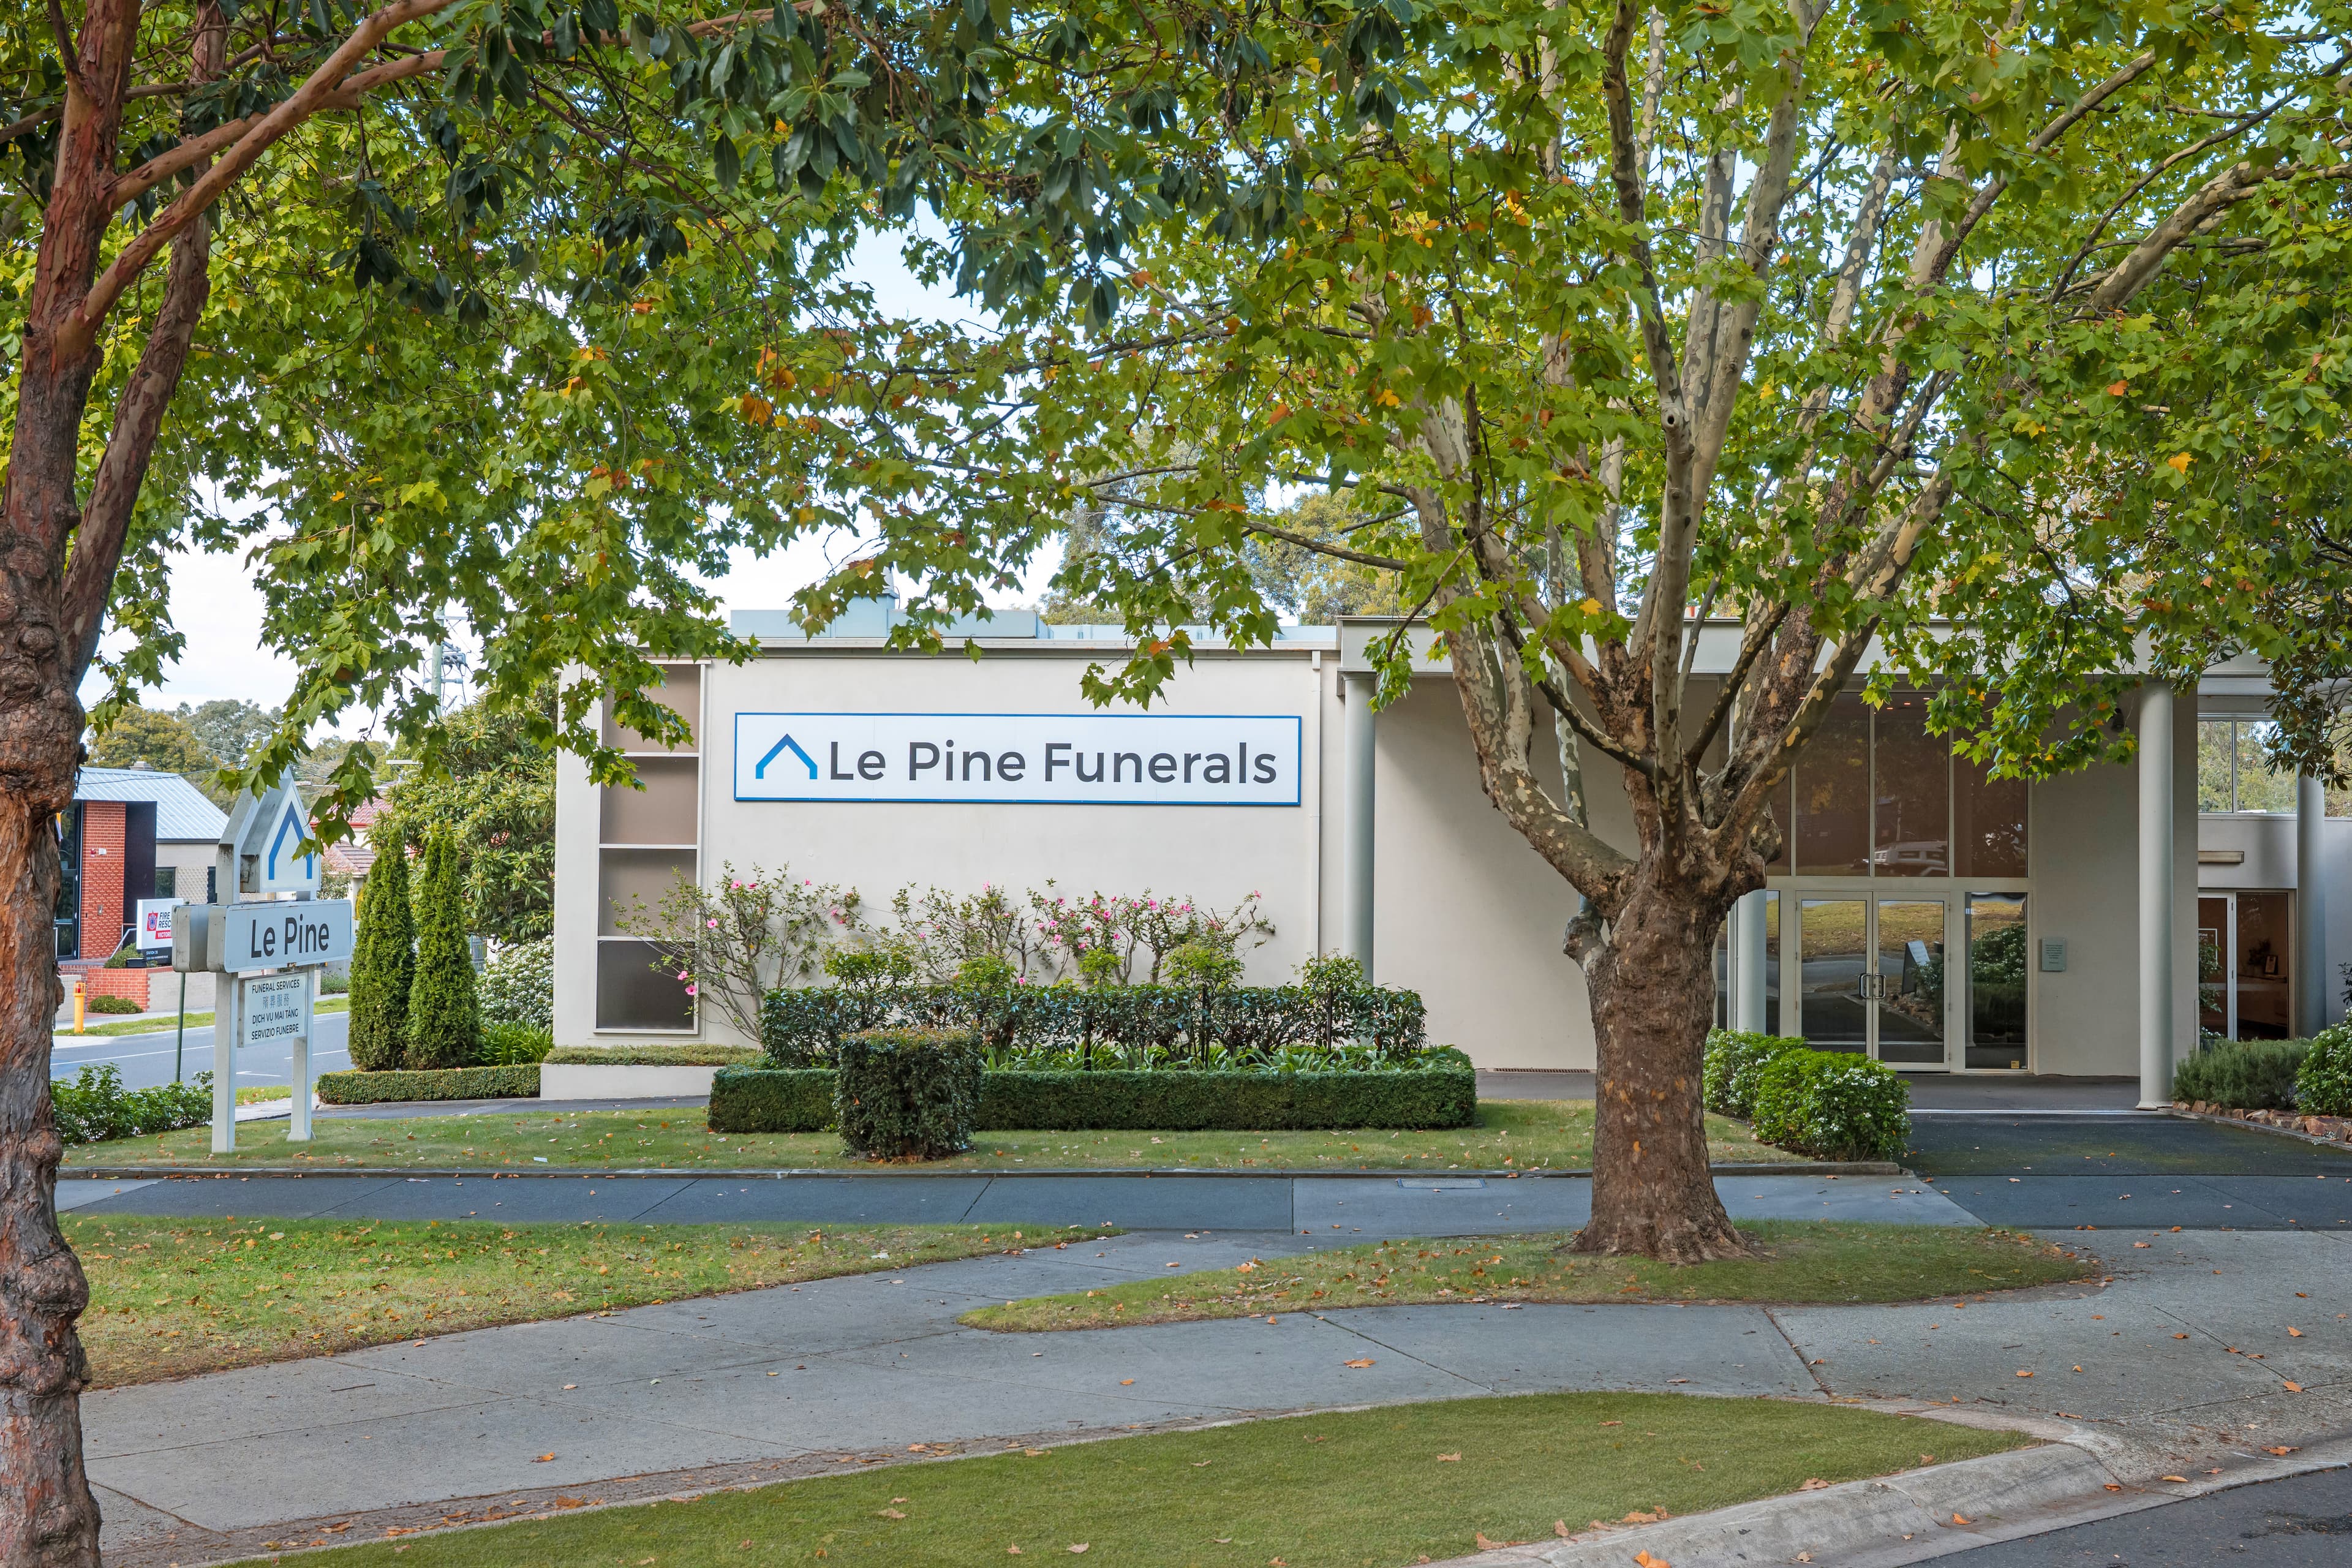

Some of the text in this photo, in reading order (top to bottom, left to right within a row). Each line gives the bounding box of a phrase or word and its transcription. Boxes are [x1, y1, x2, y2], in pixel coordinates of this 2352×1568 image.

[830, 739, 1276, 784] Le Pine Funerals
[251, 913, 330, 958] Le Pine
[252, 979, 300, 994] FUNERAL SERVICES
[252, 1014, 265, 1027] DỊCH
[266, 1012, 274, 1023] VỤ
[274, 1010, 284, 1020] MAI
[251, 1023, 299, 1040] SERVIZIO FUNEBRE
